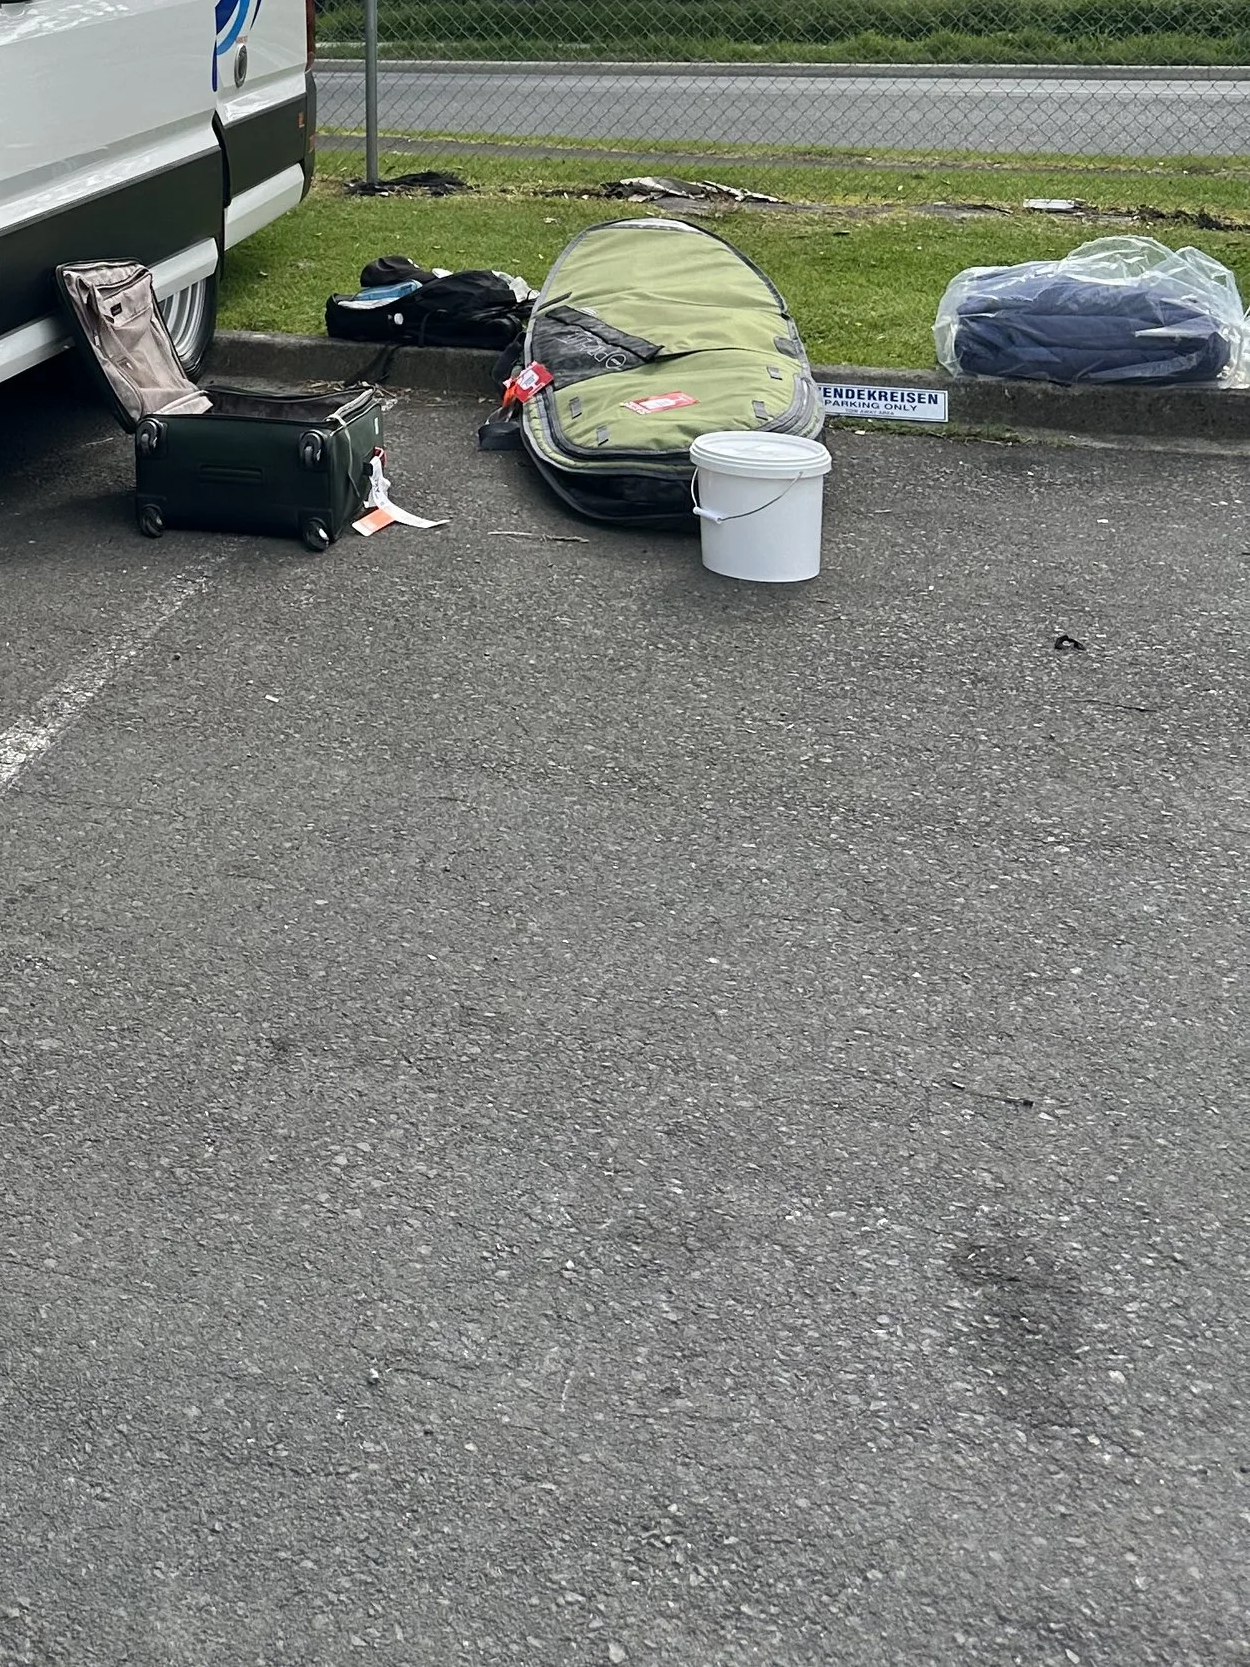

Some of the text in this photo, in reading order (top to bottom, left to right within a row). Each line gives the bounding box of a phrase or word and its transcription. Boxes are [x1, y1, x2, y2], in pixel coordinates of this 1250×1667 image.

[818, 386, 939, 405] ENDEKREISEN
[823, 399, 918, 412] PARKING ONLY
